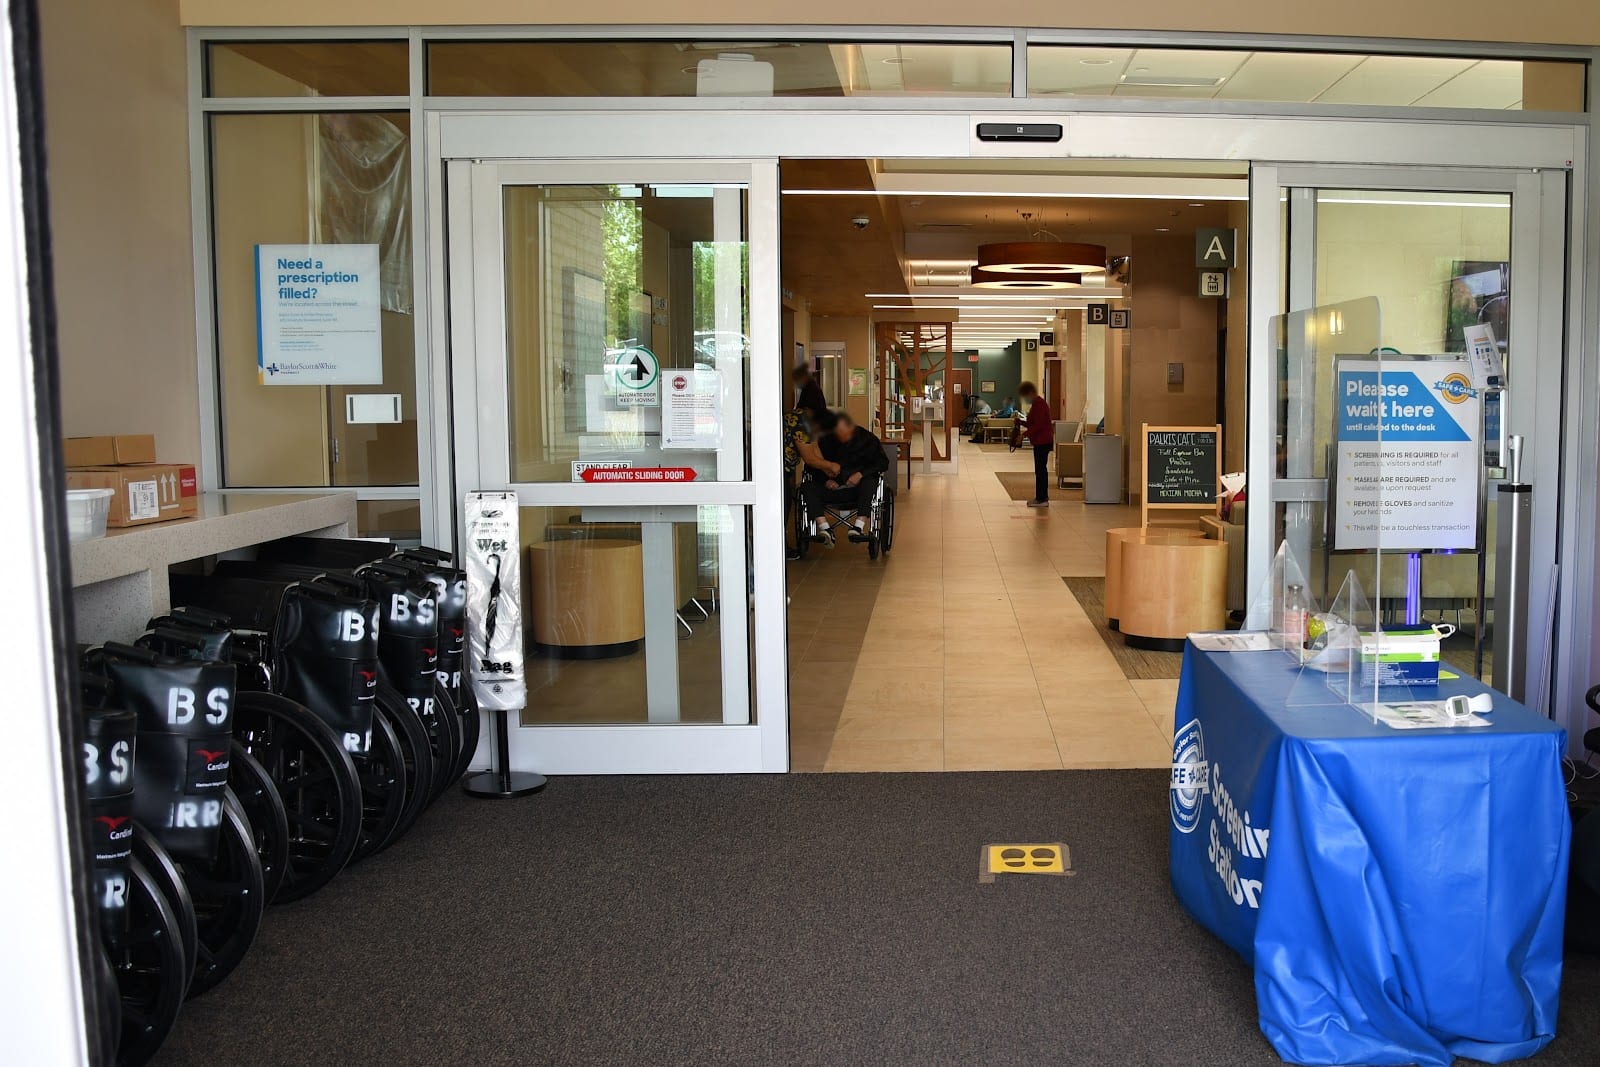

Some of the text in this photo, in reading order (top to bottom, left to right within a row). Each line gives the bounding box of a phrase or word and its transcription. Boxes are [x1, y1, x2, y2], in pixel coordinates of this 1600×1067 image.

[1203, 235, 1227, 261] A
[277, 258, 323, 269] Need a
[278, 272, 359, 286] prescription
[278, 287, 318, 299] filled?
[1092, 308, 1104, 320] B
[1027, 341, 1036, 350] D
[1042, 334, 1052, 344] C
[1438, 382, 1475, 396] SAFE CARE
[1392, 401, 1434, 418] here
[593, 471, 684, 480] AUTOMATIC SLIDING DOOR
[476, 538, 508, 552] Wet
[1196, 766, 1207, 784] CARE
[1208, 818, 1262, 908] Station
